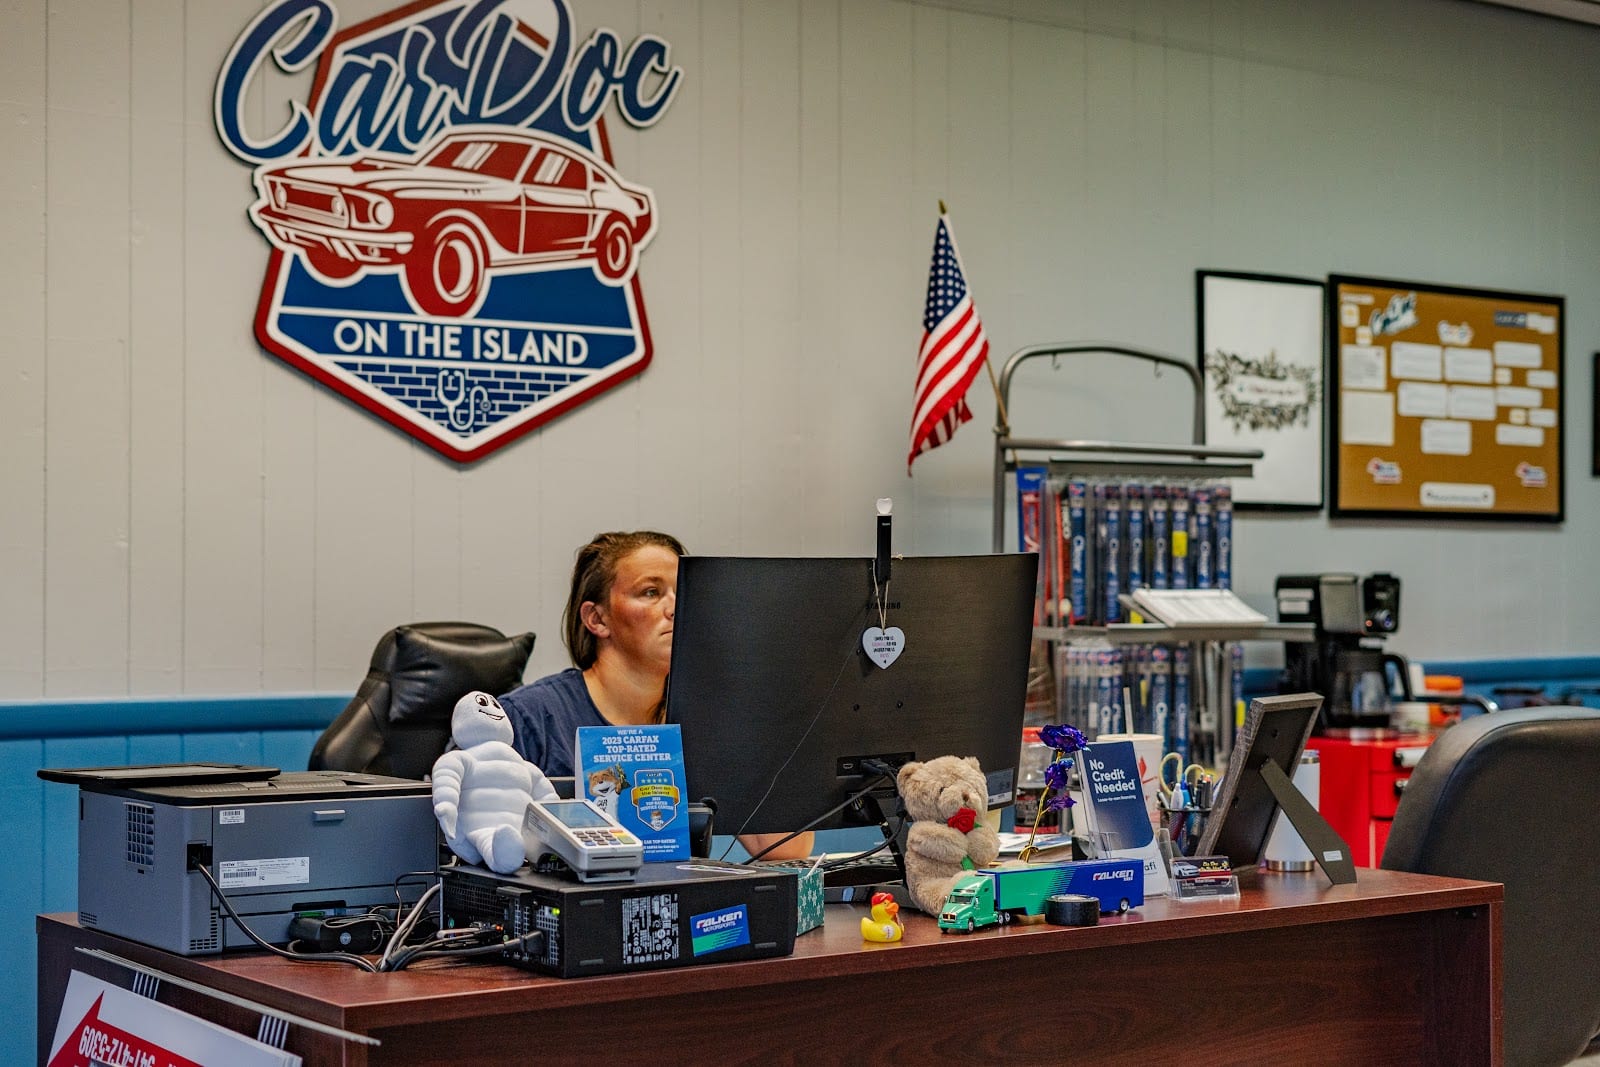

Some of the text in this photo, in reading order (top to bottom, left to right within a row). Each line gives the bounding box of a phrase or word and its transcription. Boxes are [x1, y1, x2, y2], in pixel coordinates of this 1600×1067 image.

[333, 319, 589, 365] ON THE ISLAND
[602, 735, 660, 745] 2023 CARFAX
[606, 744, 657, 753] TOP-RATED
[593, 752, 672, 763] SERVICE CENTER
[1089, 759, 1104, 770] No
[1092, 768, 1125, 782] Credit
[1092, 869, 1134, 881] FALKEN
[696, 911, 743, 929] FALKEN
